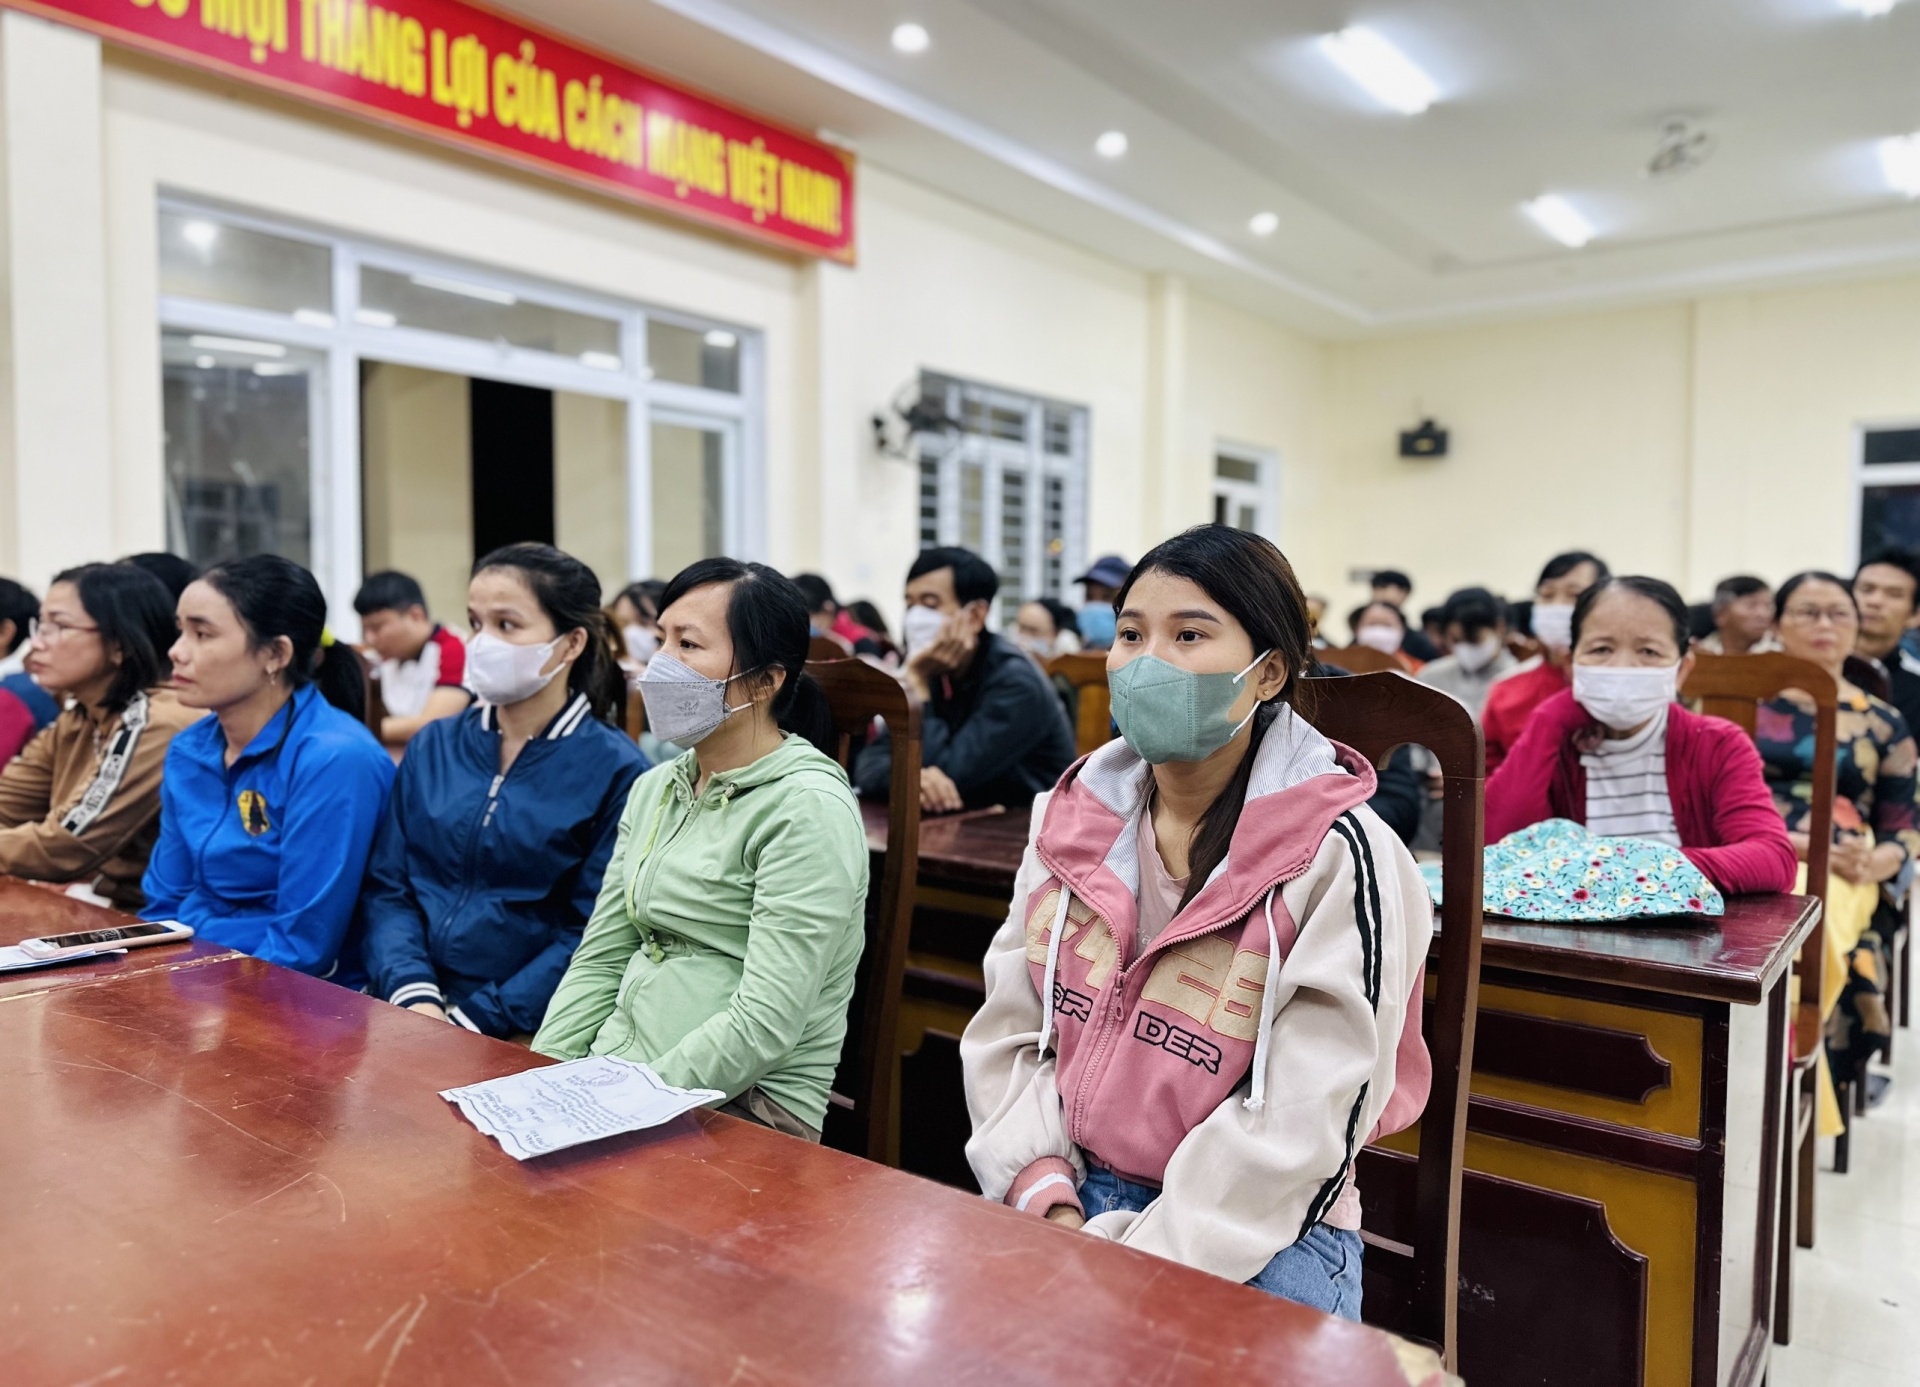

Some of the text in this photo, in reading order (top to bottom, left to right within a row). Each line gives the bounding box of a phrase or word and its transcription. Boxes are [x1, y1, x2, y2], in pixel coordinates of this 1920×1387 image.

[431, 28, 488, 129] LỢI
[492, 38, 562, 142] CỦA
[563, 74, 644, 171] CÁCH
[646, 109, 727, 199] MẠNG
[727, 136, 781, 224] VIỆT
[1133, 1010, 1223, 1075] DER
